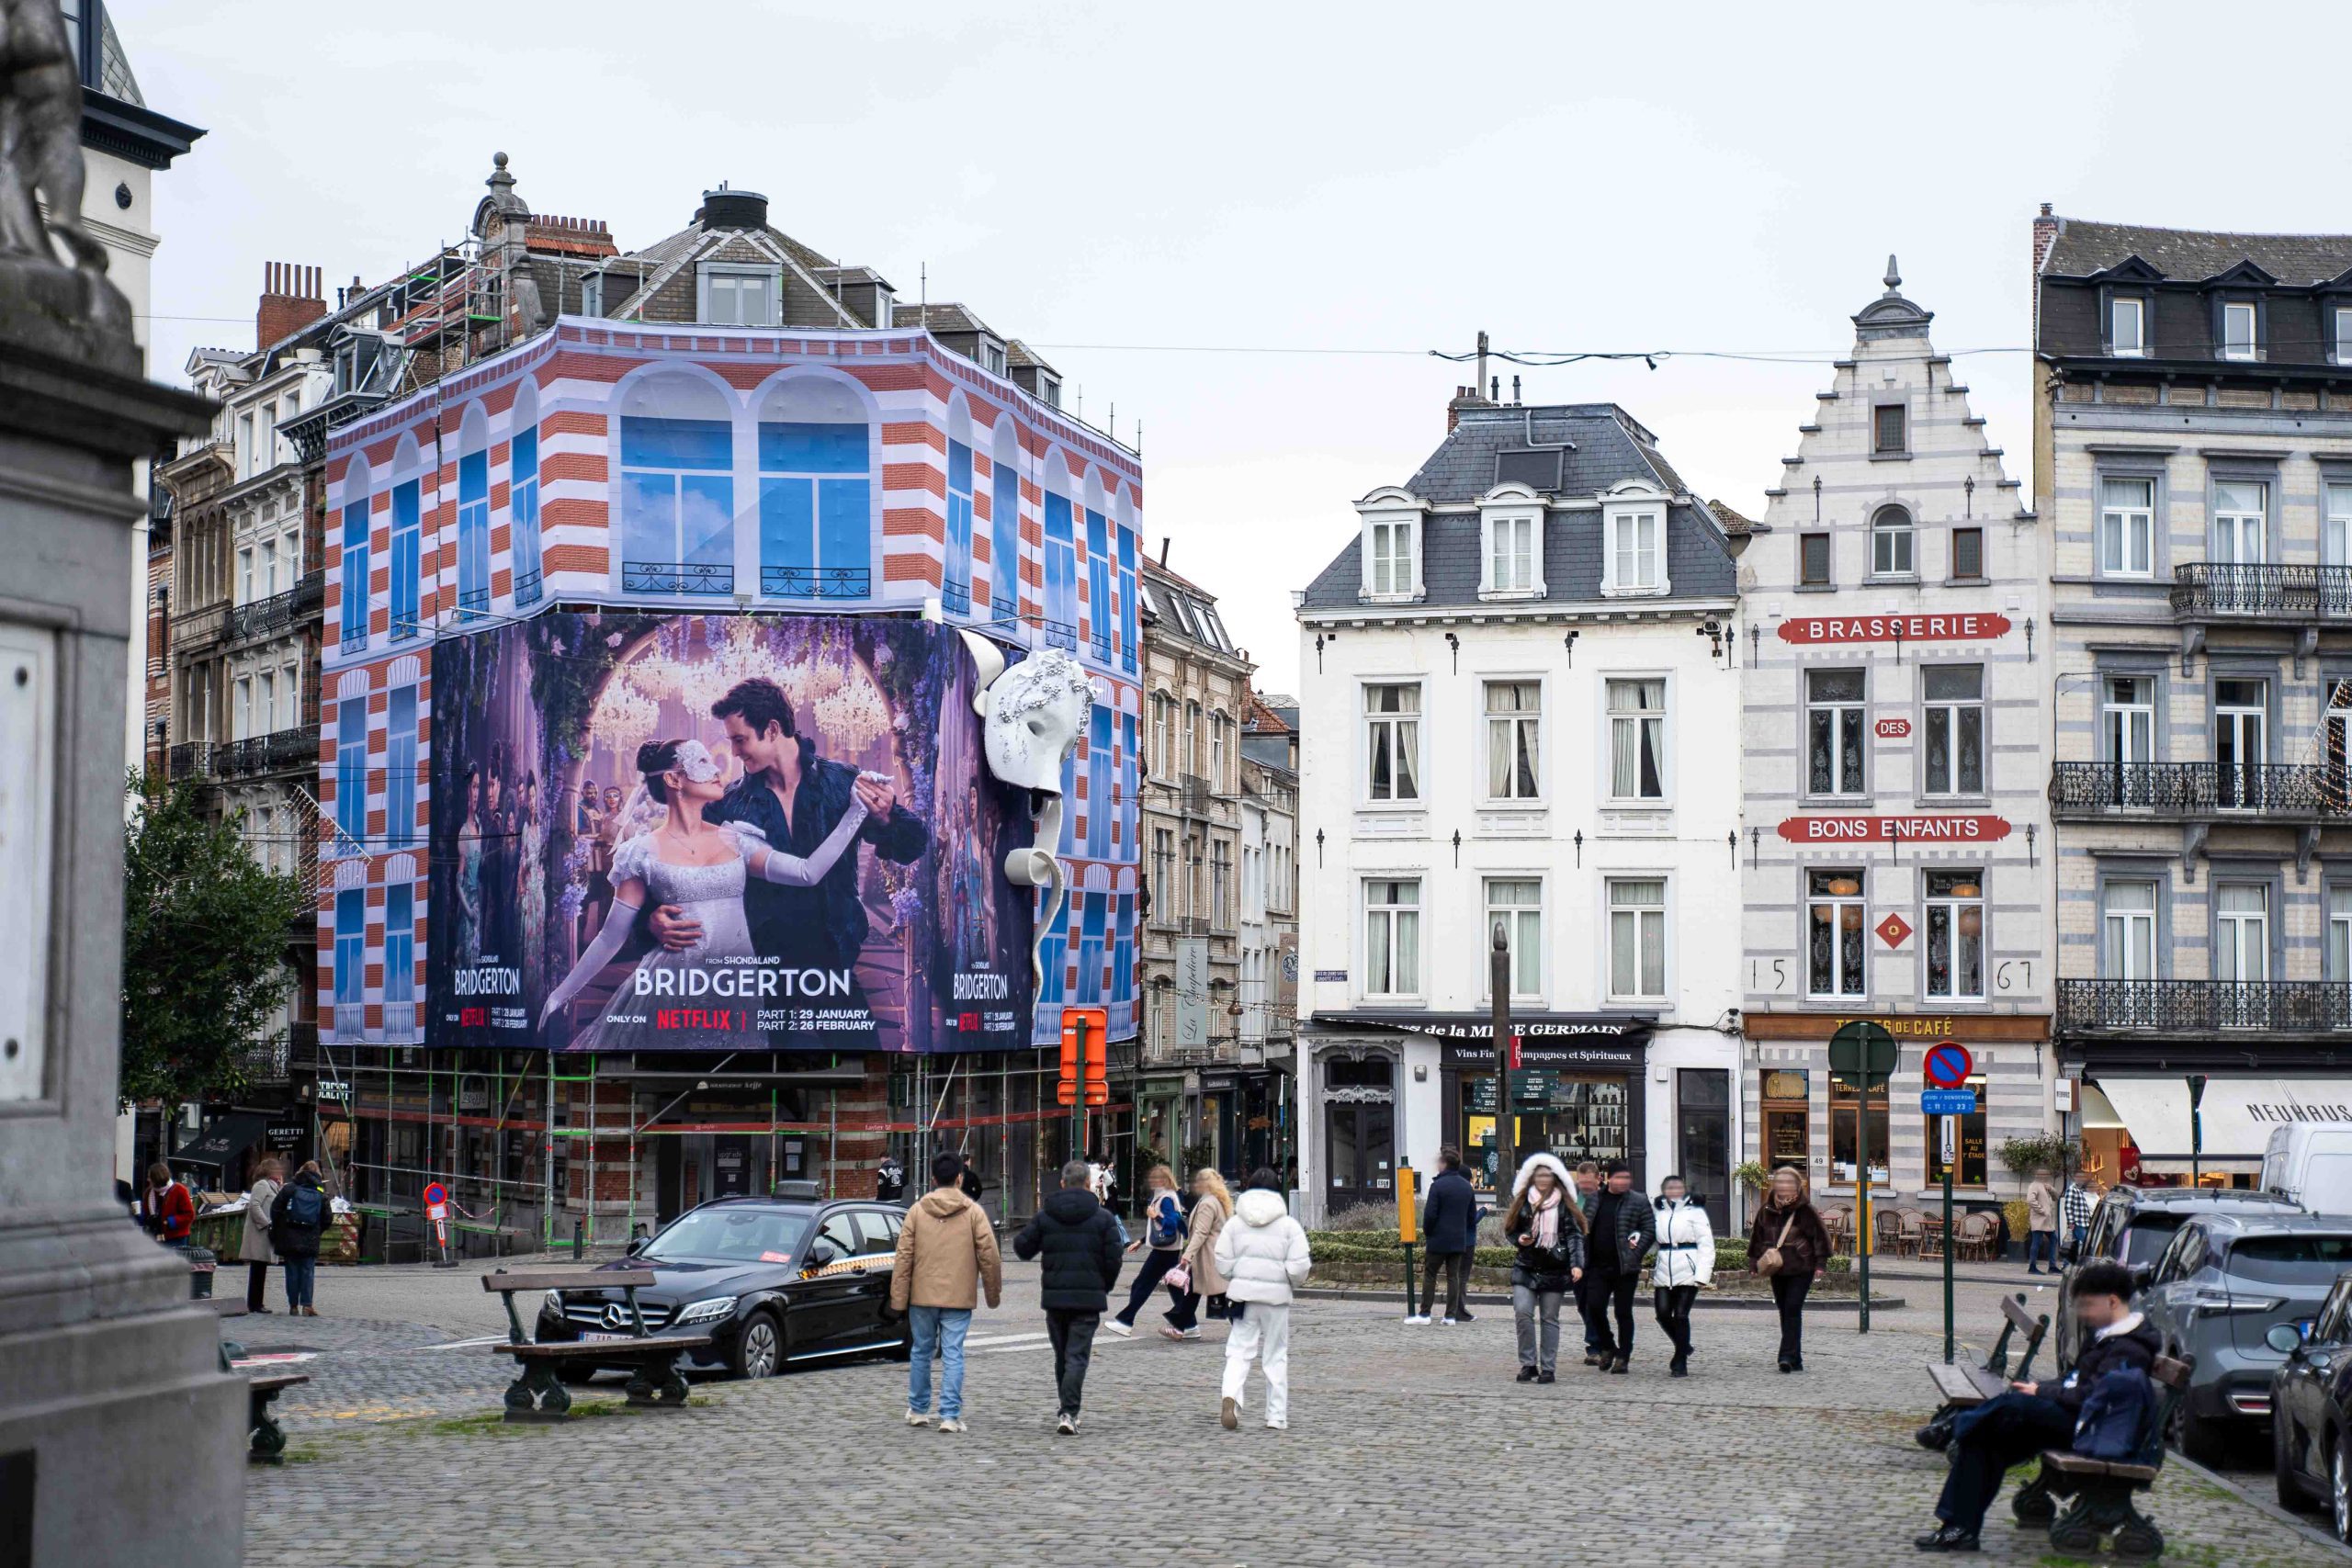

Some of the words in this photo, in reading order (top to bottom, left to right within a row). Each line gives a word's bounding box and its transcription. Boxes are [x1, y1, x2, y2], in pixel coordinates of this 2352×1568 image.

[1809, 617, 1978, 639] BRASSERIE
[1880, 722, 1906, 735] DES
[1808, 820, 1868, 838] BONS
[1881, 820, 1979, 838] ENFANTS
[724, 955, 780, 964] SHONDALAND
[454, 967, 520, 996] BRIDGERTON
[634, 968, 851, 997] BRIDGERTON
[953, 973, 1008, 1000] BRIDGERTON
[606, 1015, 630, 1023] ONLY
[632, 1015, 647, 1023] ON
[656, 1009, 731, 1030] NETFLIX
[757, 1010, 786, 1020] PART
[788, 1010, 798, 1020] 1:
[799, 1010, 813, 1020] 29
[815, 1010, 869, 1020] JANUARY
[757, 1021, 786, 1031] PART
[788, 1021, 798, 1031] 2:
[799, 1021, 813, 1031] 26
[816, 1021, 876, 1031] FEBRUARY
[1425, 1025, 1446, 1036] de
[1449, 1024, 1465, 1037] la
[1469, 1024, 1526, 1037] ME
[1530, 1024, 1627, 1036] GERMAIN
[1895, 1021, 1910, 1033] DE
[1914, 1017, 1953, 1035] CAFÉ
[1455, 1049, 1478, 1058] Vins
[1479, 1049, 1495, 1058] Fin
[1568, 1051, 1578, 1059] et
[1579, 1051, 1632, 1061] Spiritueux
[2245, 1103, 2352, 1122] NEUHAUS
